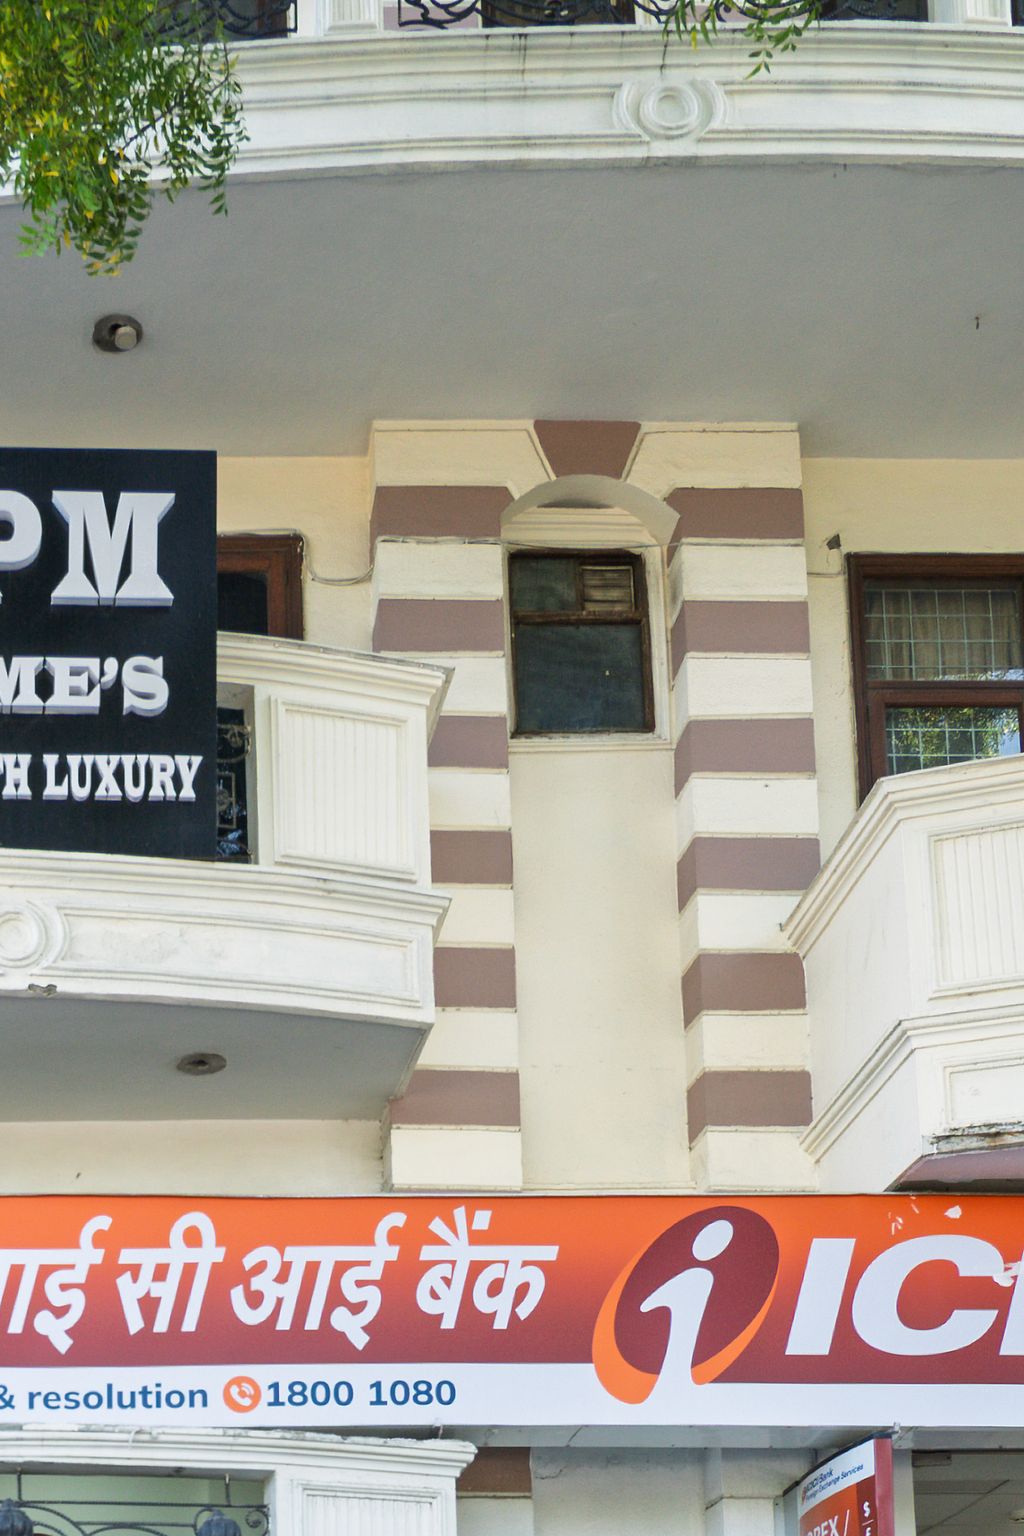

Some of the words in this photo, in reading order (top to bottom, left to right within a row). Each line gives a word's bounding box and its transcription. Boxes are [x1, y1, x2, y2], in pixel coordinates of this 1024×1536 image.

[42, 754, 203, 802] LUXURY
[115, 1212, 226, 1335] सी
[229, 1212, 406, 1351] आई
[415, 1205, 559, 1330] बैंक
[27, 1384, 209, 1409] resolution
[266, 1381, 354, 1407] 1800
[369, 1380, 456, 1406] 1080
